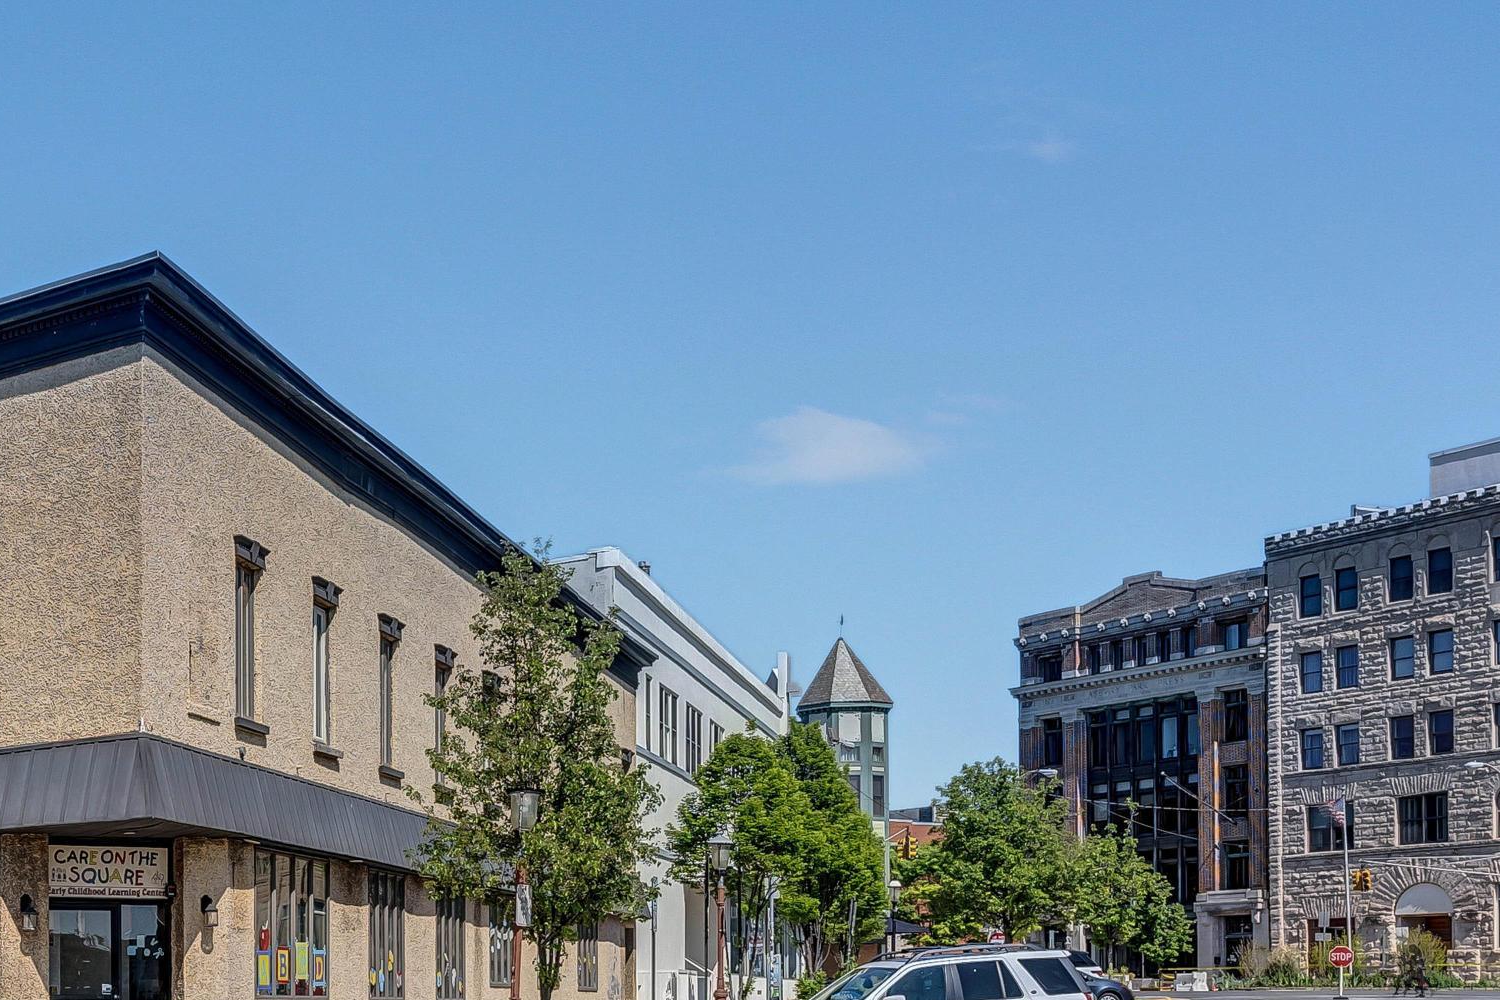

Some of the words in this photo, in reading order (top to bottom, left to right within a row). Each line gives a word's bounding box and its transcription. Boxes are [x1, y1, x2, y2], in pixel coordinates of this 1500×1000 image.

[54, 849, 99, 865] CARE
[100, 849, 127, 865] ON
[128, 850, 159, 866] THE
[68, 866, 145, 886] SQUARE
[67, 887, 106, 896] Childhood
[108, 888, 141, 897] Learning
[142, 888, 167, 897] Center
[1331, 952, 1352, 961] STOP
[280, 954, 286, 977] B
